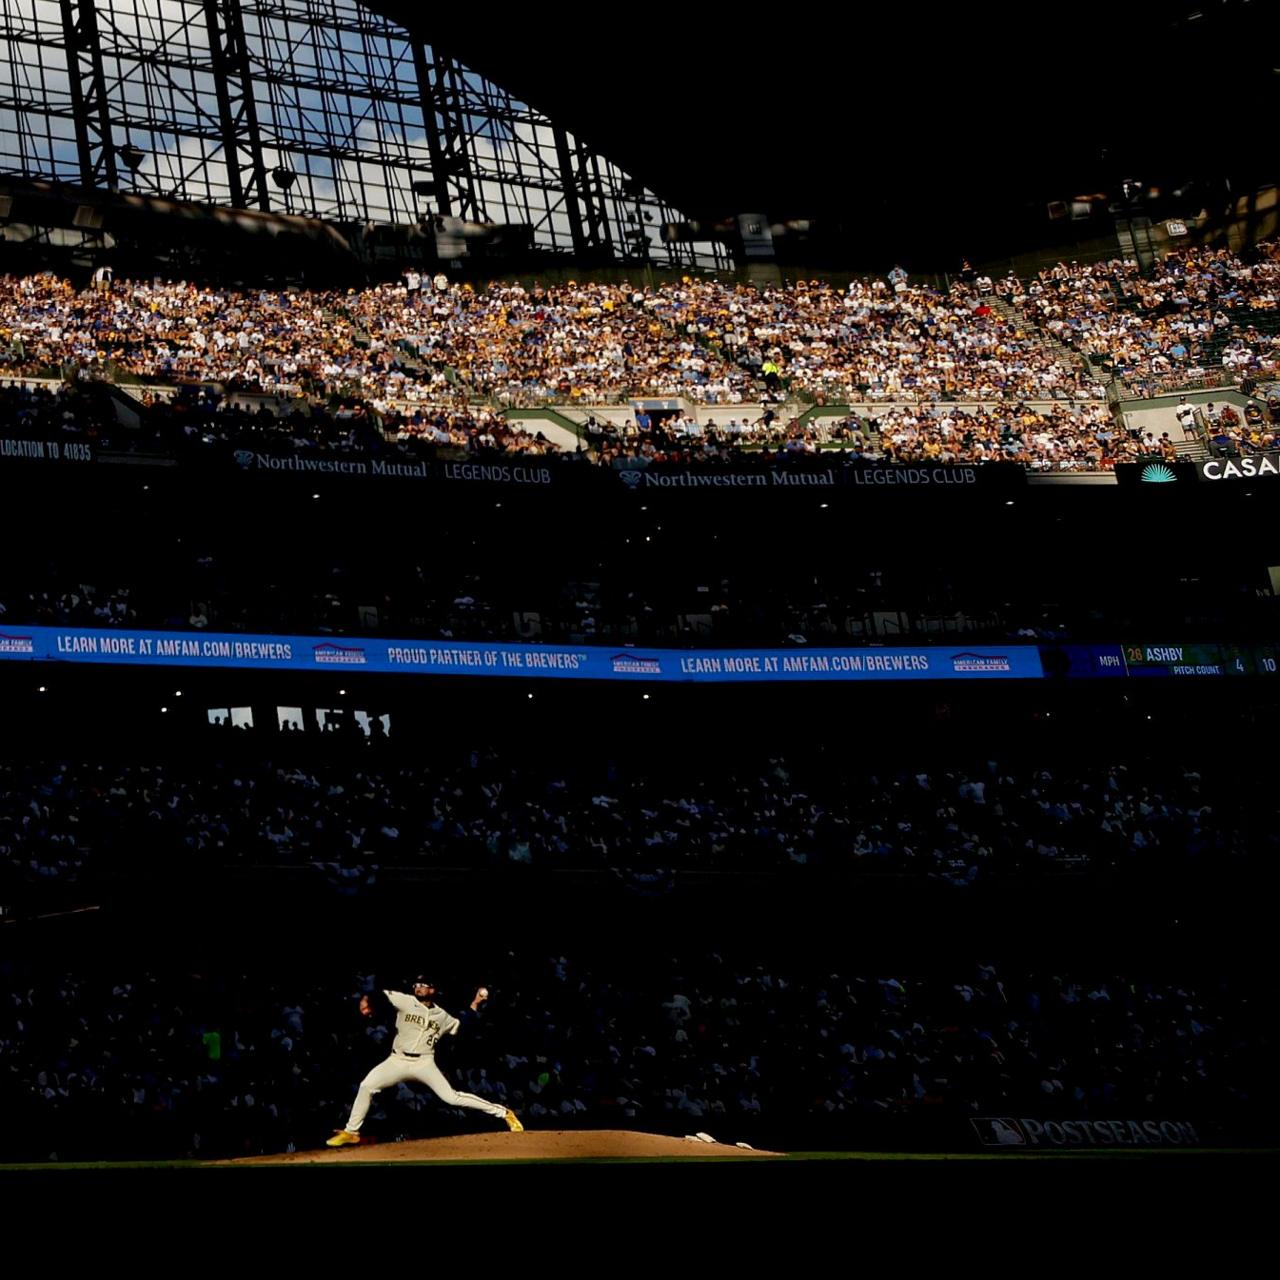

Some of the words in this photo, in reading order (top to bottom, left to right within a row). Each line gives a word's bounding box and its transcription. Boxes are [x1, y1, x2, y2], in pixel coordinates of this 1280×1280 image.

[0, 439, 45, 459] LOCATION
[47, 441, 60, 459] TO
[63, 442, 92, 462] 41835
[256, 452, 369, 476] Northwestern
[372, 458, 428, 479] Mutual
[444, 463, 511, 483] LEGENDS
[513, 466, 551, 485] CLUB
[1203, 455, 1280, 480] CASA
[644, 470, 767, 488] Northwestern
[770, 468, 836, 486] Mutual
[854, 468, 930, 485] LEGENDS
[933, 468, 976, 485] CLUB
[57, 635, 95, 653] LEARN
[100, 637, 136, 655] MORE
[139, 639, 154, 655] AT
[156, 640, 292, 660] AMFAM.COM/BREWERS
[387, 647, 427, 664] PROUD
[430, 649, 481, 667] PARTNER
[484, 651, 498, 667] OF
[501, 652, 523, 668] THE
[1146, 646, 1184, 661] ASHBY
[680, 657, 720, 673] LEARN
[724, 657, 761, 673] MORE
[764, 656, 779, 672] AT
[783, 654, 929, 673] AMFAM.COM/BREWERS
[1099, 655, 1120, 667] MPH
[1174, 665, 1195, 675] PITCH
[1196, 665, 1220, 675] COUNT
[1262, 658, 1277, 673] 10
[1019, 1118, 1201, 1144] POSTSEASON
